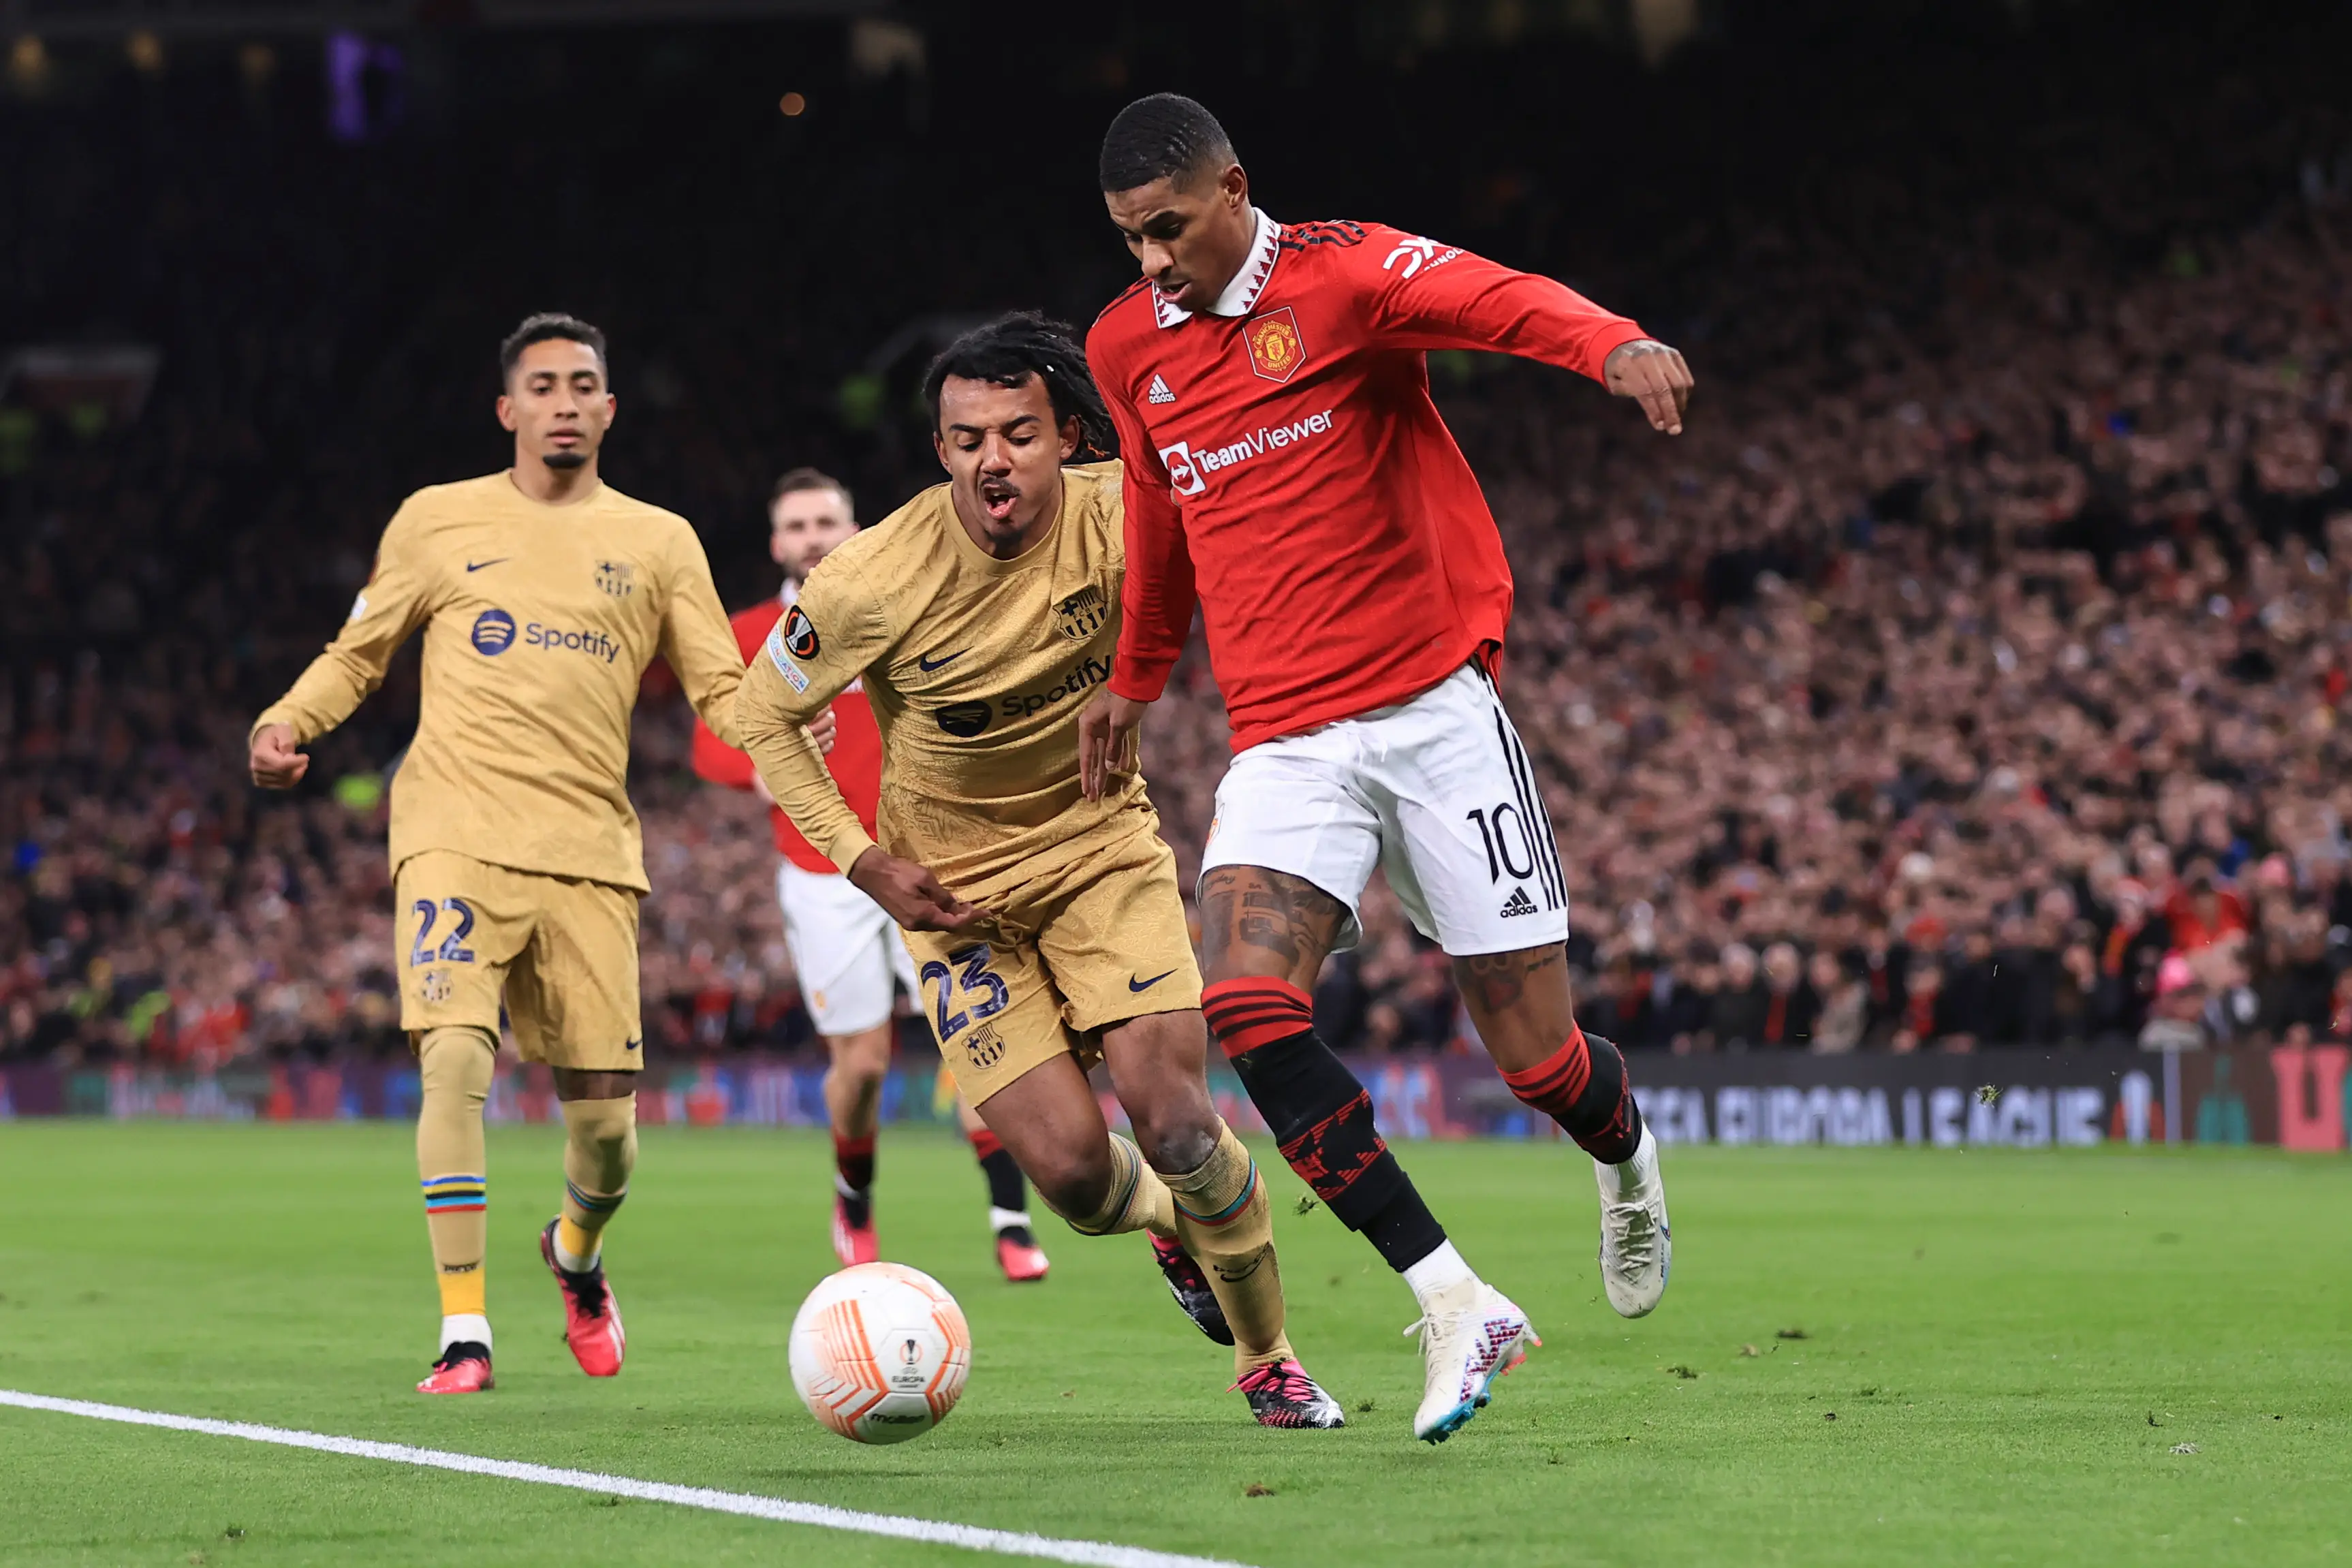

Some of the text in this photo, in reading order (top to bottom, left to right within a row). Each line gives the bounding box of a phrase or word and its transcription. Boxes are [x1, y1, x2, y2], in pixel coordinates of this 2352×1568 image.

[1256, 324, 1290, 345] MANCHESTER
[1268, 355, 1291, 368] UNITED
[1148, 392, 1176, 404] adidas
[1191, 409, 1332, 473] TeamViewer
[525, 623, 620, 663] Spotify
[1001, 655, 1111, 717] Spotify
[1466, 802, 1533, 885] 10
[411, 898, 475, 968] 22
[1500, 905, 1538, 918] adidas
[921, 943, 1009, 1044] 23
